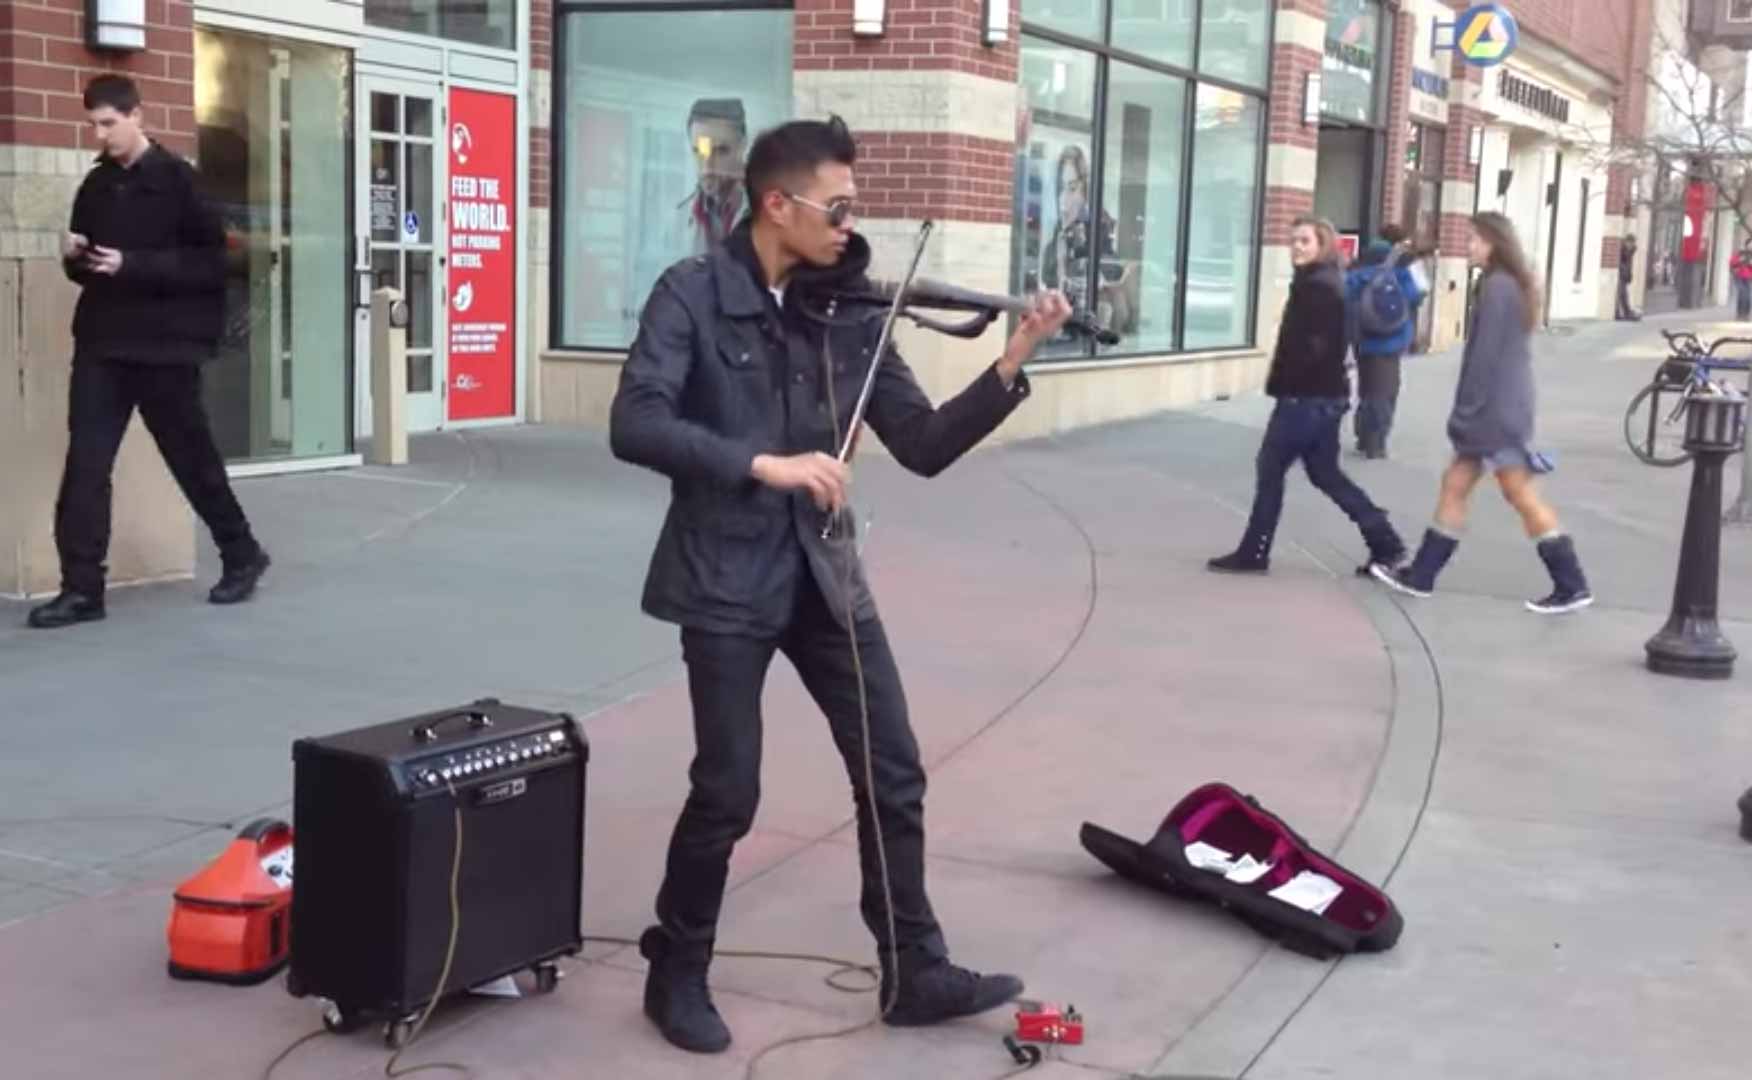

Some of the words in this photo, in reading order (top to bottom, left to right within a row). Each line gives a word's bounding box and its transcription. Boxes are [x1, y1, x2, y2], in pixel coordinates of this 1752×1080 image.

[451, 176, 478, 198] FEED
[479, 178, 500, 200] THE
[451, 200, 512, 232] WORLD.
